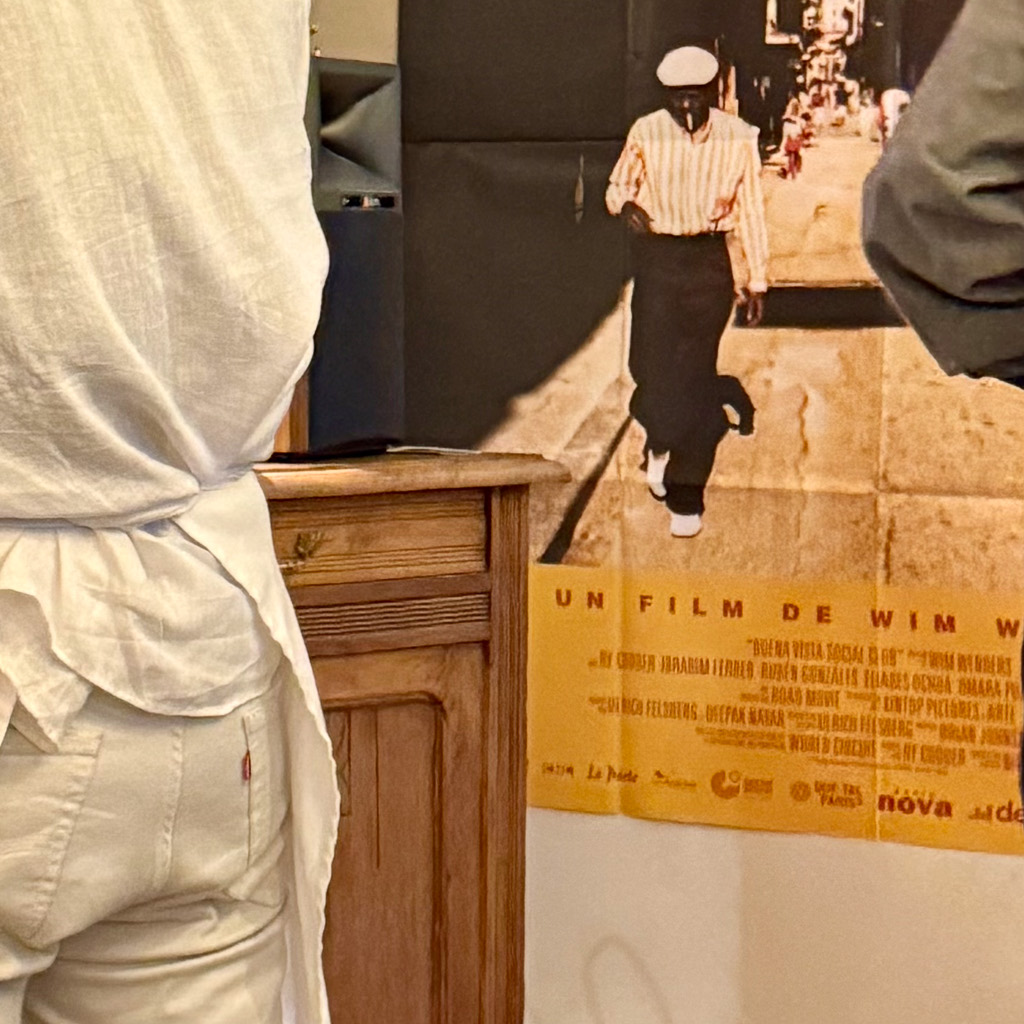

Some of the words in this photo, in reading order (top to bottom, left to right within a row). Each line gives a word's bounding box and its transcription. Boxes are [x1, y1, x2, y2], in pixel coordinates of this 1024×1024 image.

[555, 588, 605, 610] UN
[639, 594, 744, 619] FILM
[782, 602, 832, 624] DE
[871, 609, 956, 633] WIM
[878, 794, 952, 818] nova
